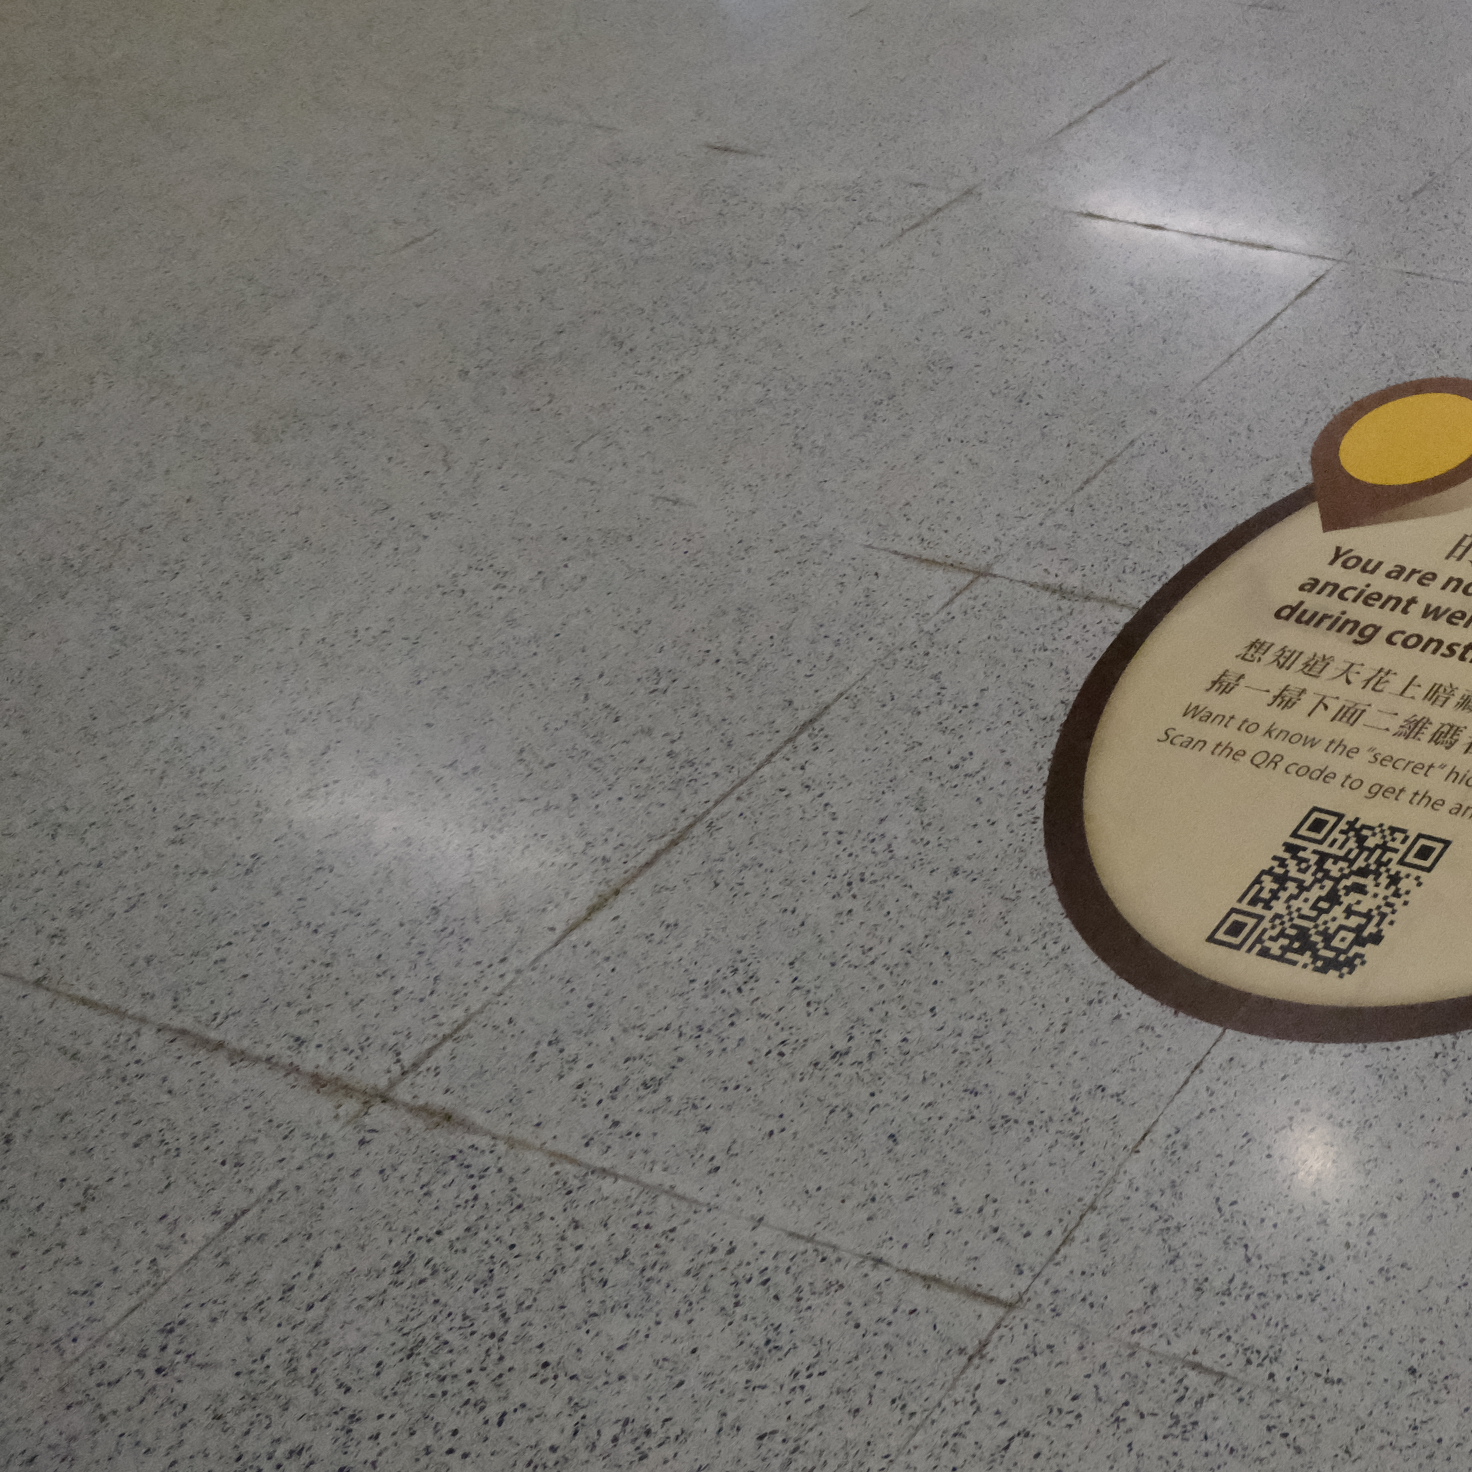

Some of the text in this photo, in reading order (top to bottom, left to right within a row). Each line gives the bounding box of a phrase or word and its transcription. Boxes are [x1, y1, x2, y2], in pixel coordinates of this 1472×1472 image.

[1328, 546, 1384, 575] You
[1385, 564, 1438, 586] are
[1298, 576, 1419, 615] ancient
[1273, 600, 1383, 645] during
[1182, 702, 1236, 728] Want
[1237, 717, 1261, 734] to
[1262, 722, 1322, 749] know
[1324, 738, 1360, 759] the
[1157, 727, 1208, 752] Scan
[1210, 740, 1247, 762] the
[1250, 750, 1285, 771] QR
[1284, 760, 1337, 785] code
[1341, 773, 1363, 791] to
[1363, 780, 1407, 803] get
[1412, 786, 1447, 810] the
